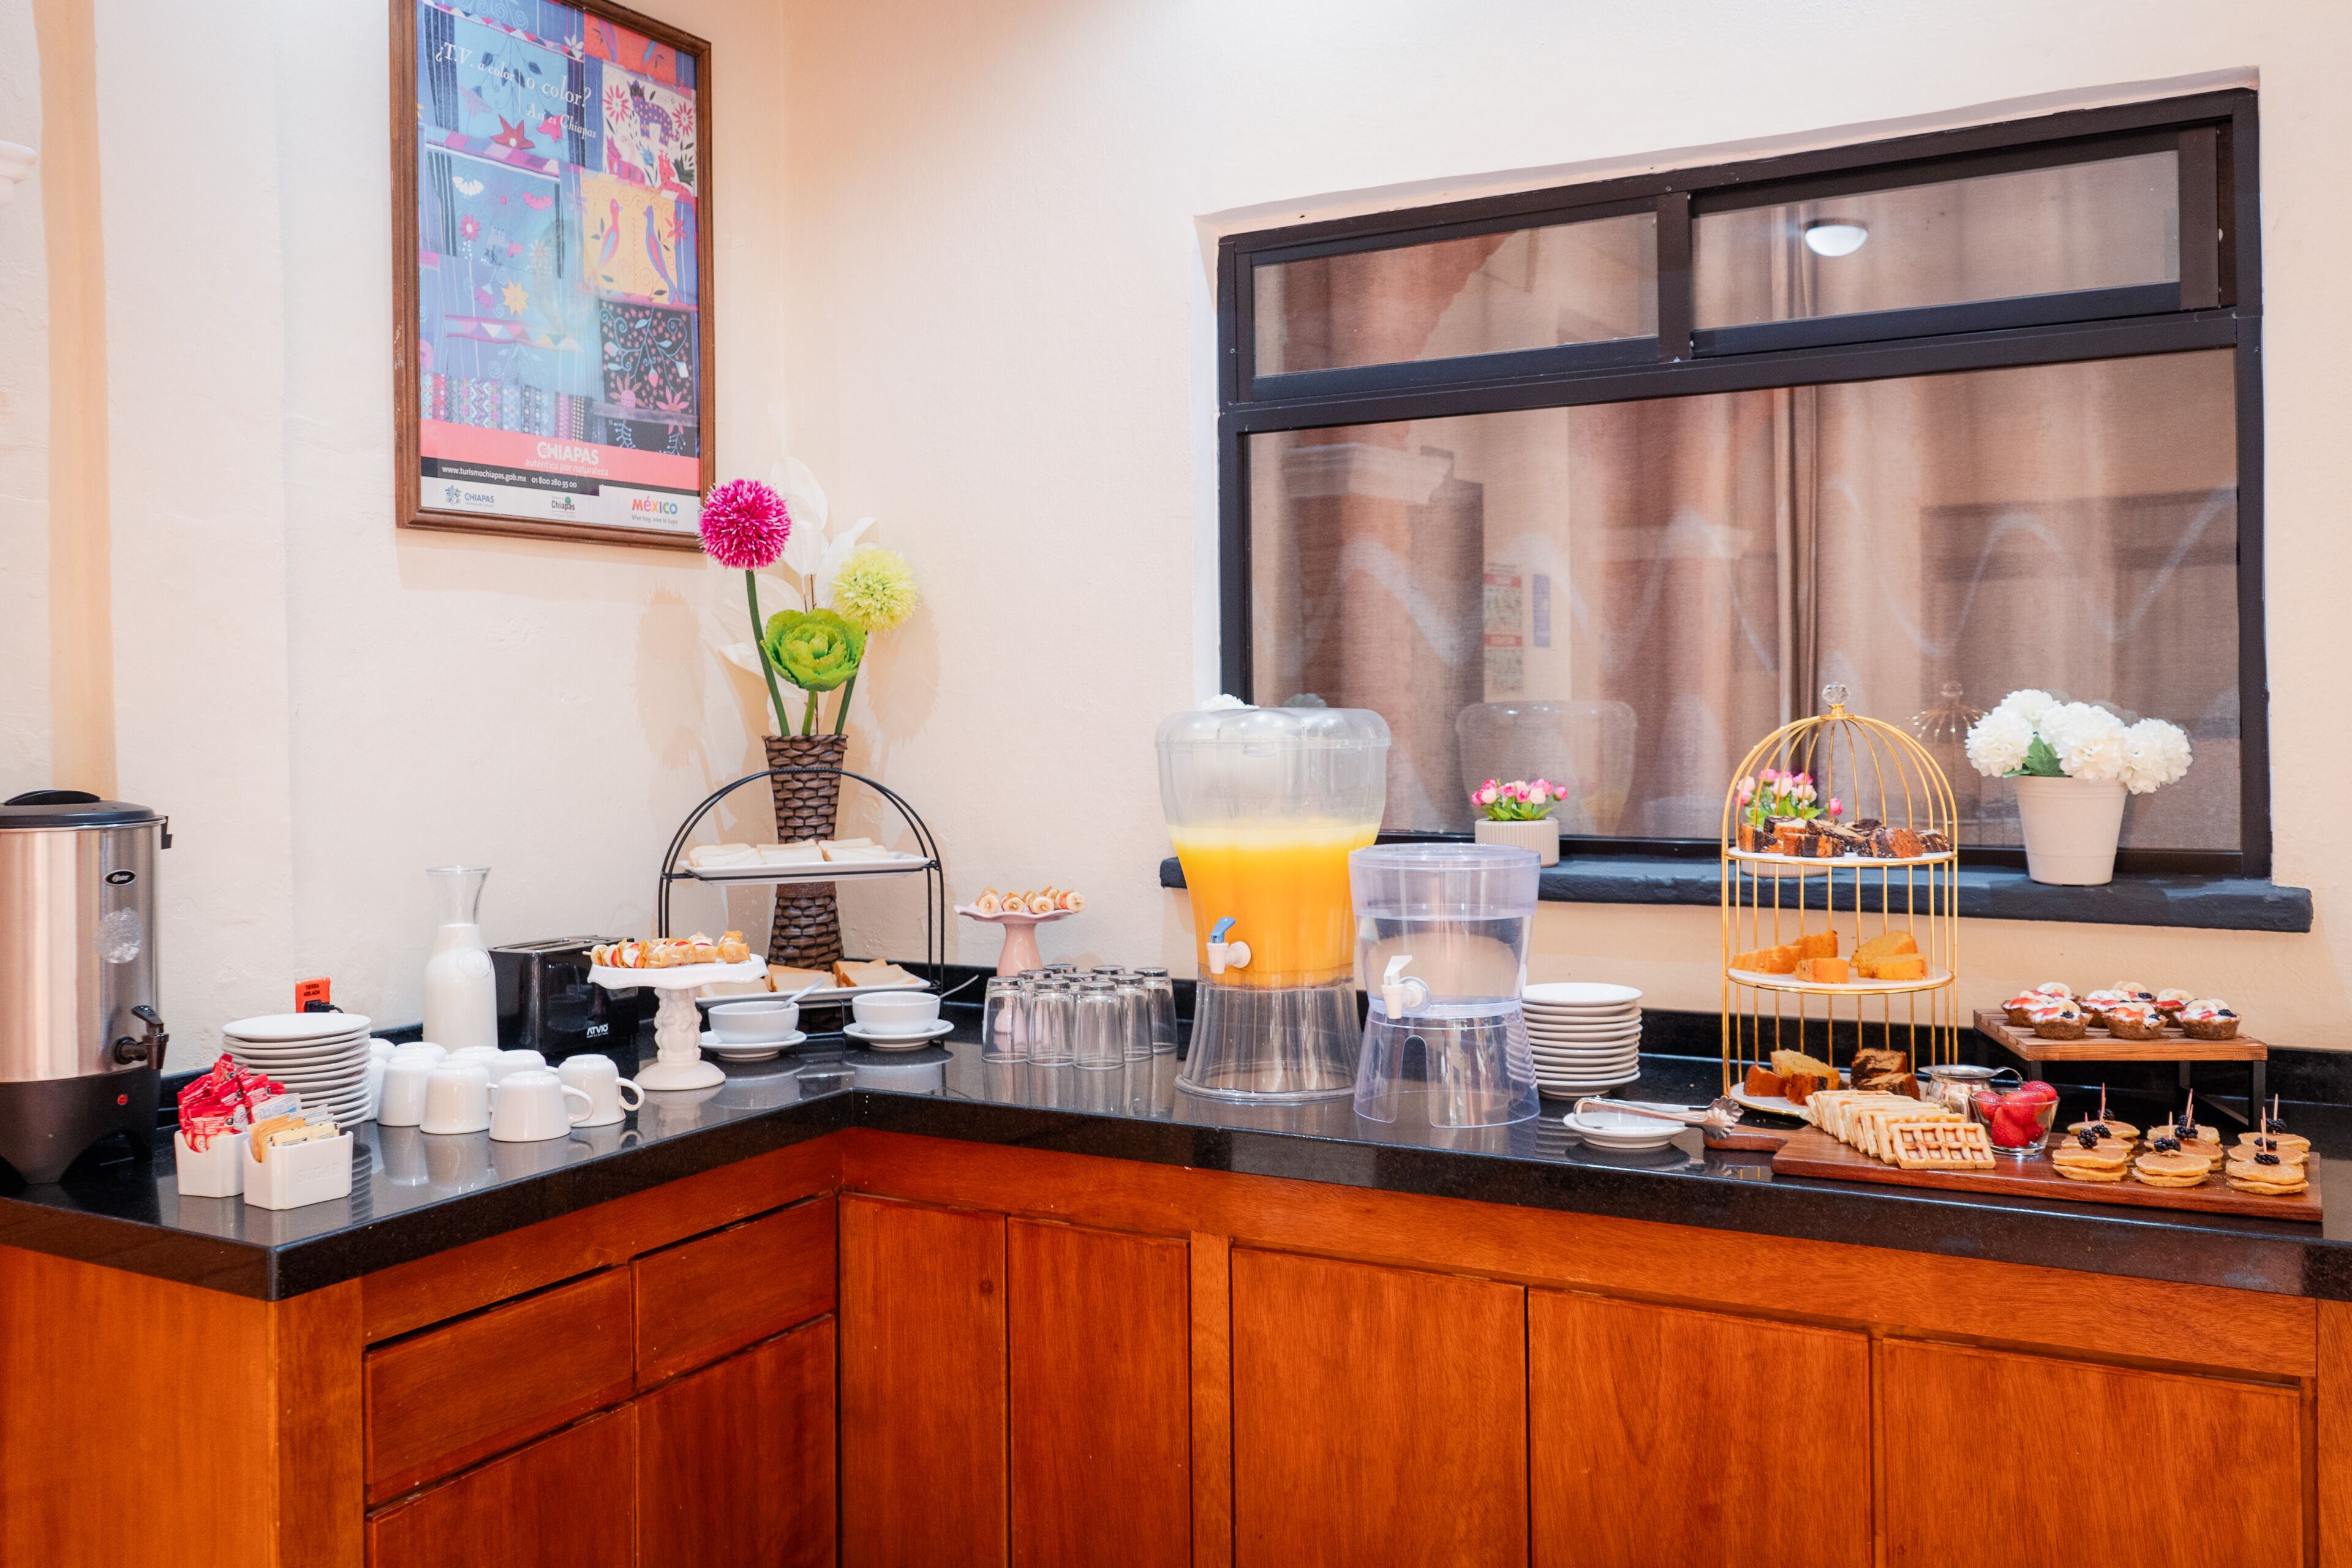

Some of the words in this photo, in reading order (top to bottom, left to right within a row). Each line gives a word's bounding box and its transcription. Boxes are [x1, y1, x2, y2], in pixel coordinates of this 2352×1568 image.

[435, 42, 473, 67] ¿T.V.
[488, 61, 515, 81] color
[541, 75, 592, 108] color?
[548, 116, 557, 126] es
[560, 114, 597, 140] Chiapas
[537, 441, 599, 466] CHIAPAS
[442, 466, 527, 483] www.turismochiapas.gob.mx
[538, 477, 551, 485] 800
[525, 459, 559, 470] auténtico
[560, 464, 571, 472] por
[573, 466, 609, 477] naturaleza
[464, 492, 494, 503] CHIAPAS
[551, 500, 576, 511] Chiapas
[587, 1024, 608, 1035] ATVIO
